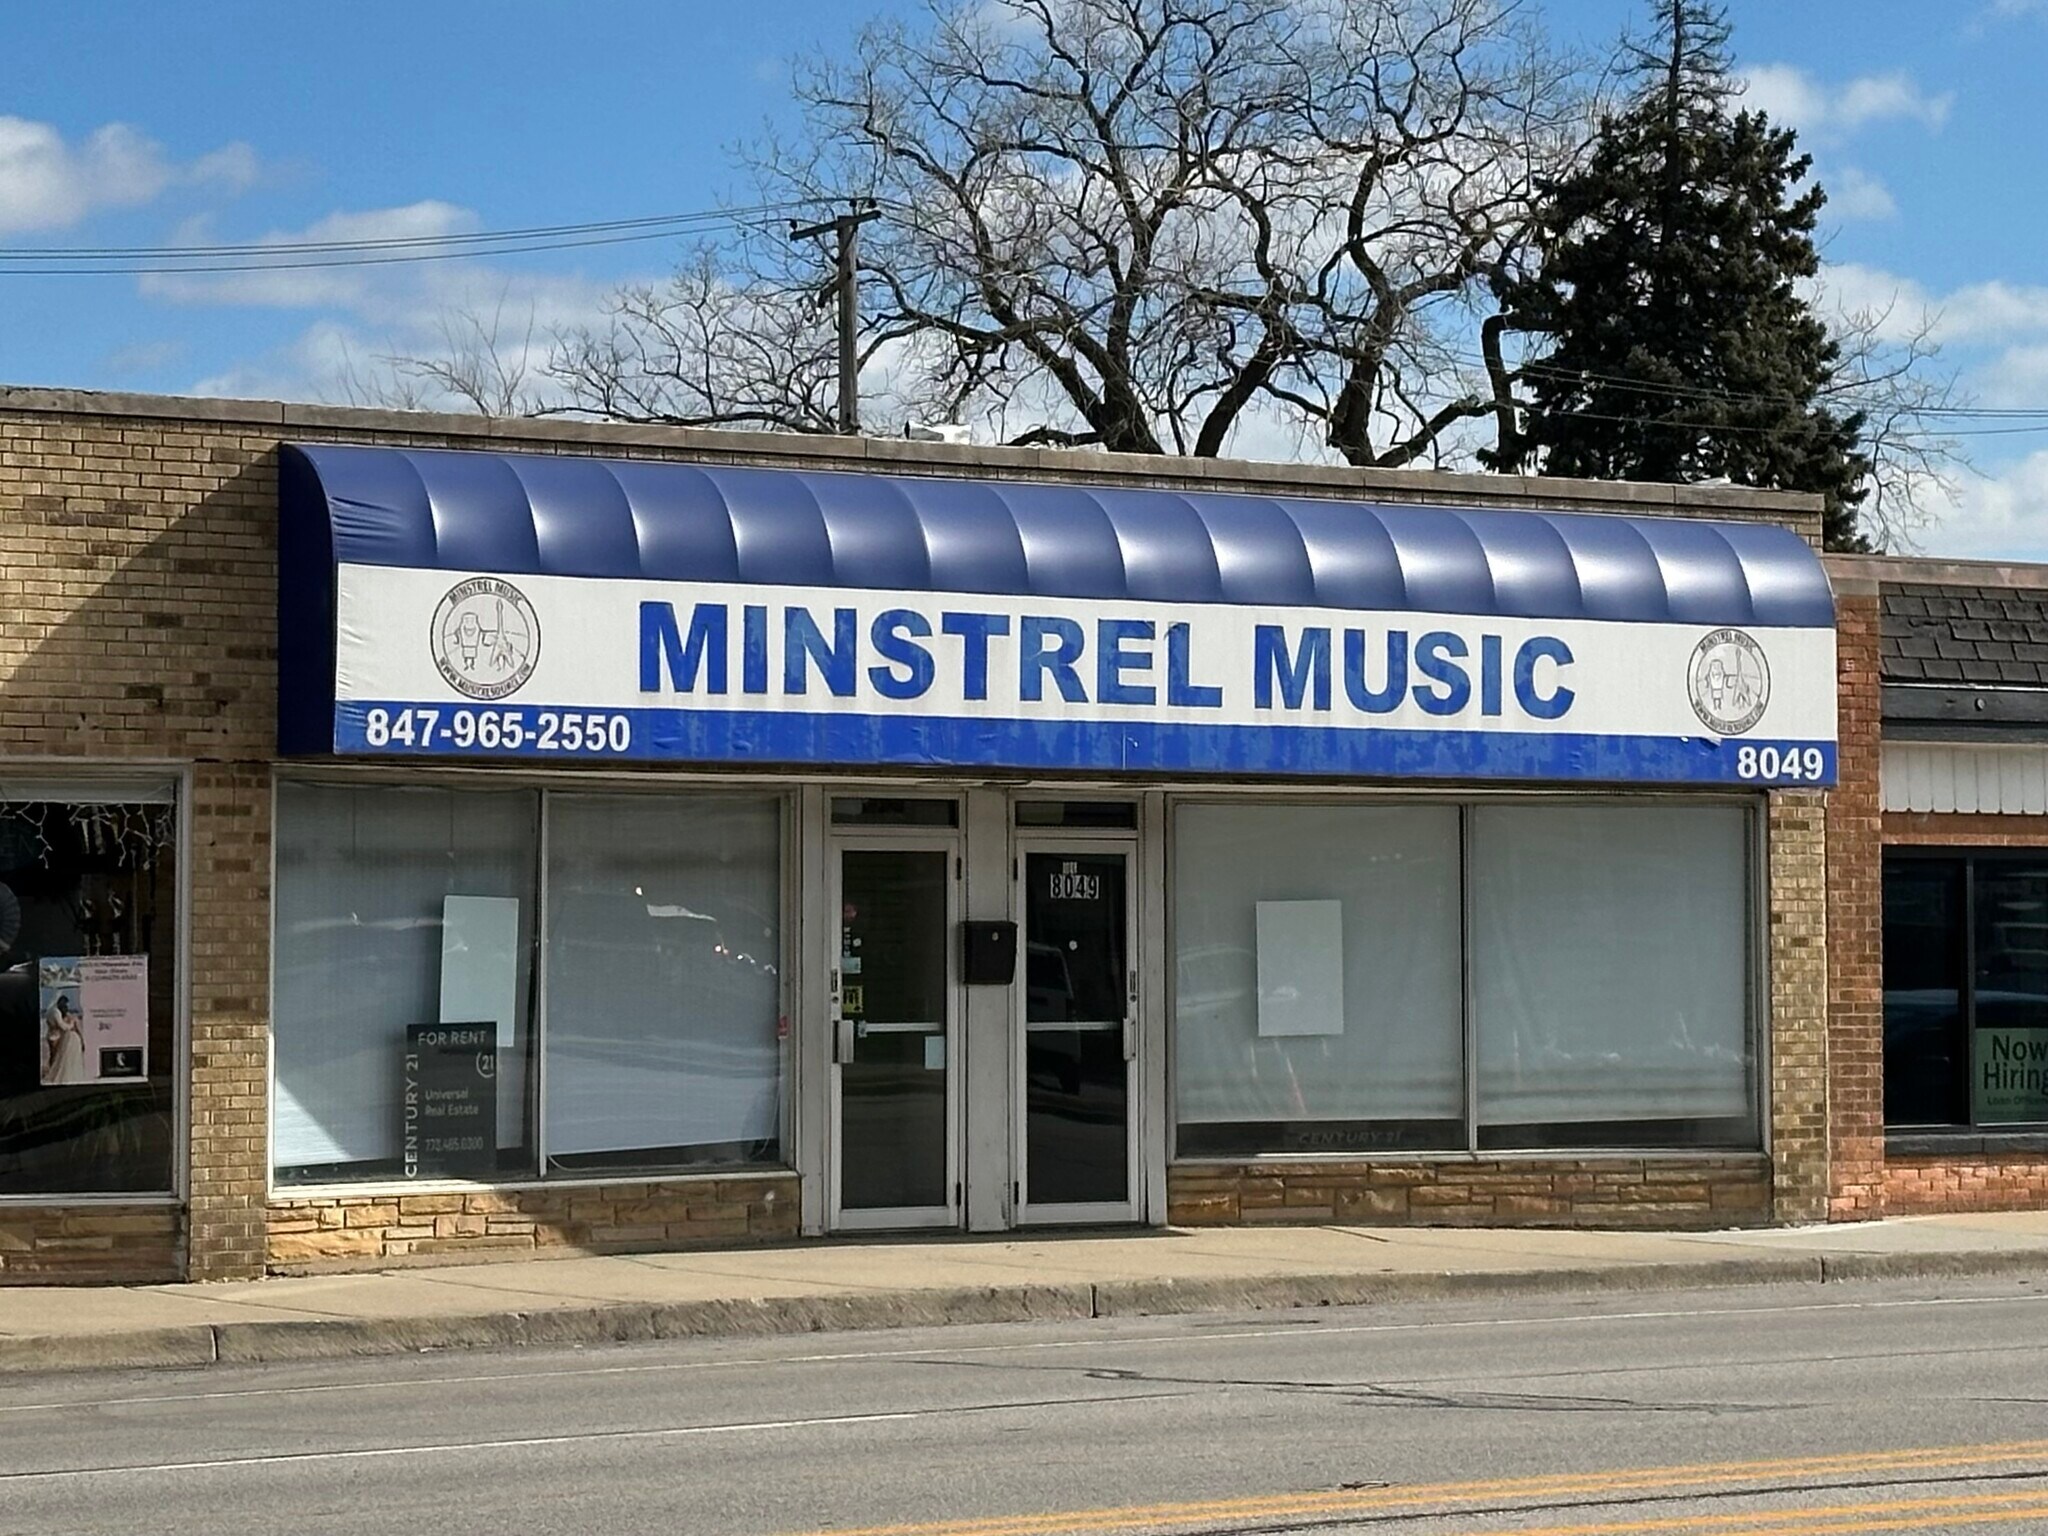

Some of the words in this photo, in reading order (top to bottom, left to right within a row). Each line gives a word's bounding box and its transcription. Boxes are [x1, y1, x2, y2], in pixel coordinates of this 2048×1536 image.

[449, 580, 493, 607] MINSTREL
[495, 582, 523, 607] MUSIC
[639, 601, 1223, 708] MINSTREL
[1254, 624, 1575, 720] MUSIC
[366, 708, 632, 752] 847-965-2550
[1737, 746, 1824, 780] 8049
[1052, 874, 1098, 898] 8049
[418, 1032, 447, 1046] FOR
[451, 1030, 487, 1045] RENT
[1992, 1034, 2048, 1061] Now
[406, 1054, 418, 1071] 21
[482, 1055, 494, 1070] 21
[425, 1087, 469, 1101] Universal
[425, 1104, 445, 1117] Real
[448, 1104, 479, 1117] Estate
[405, 1077, 418, 1178] CENTURY
